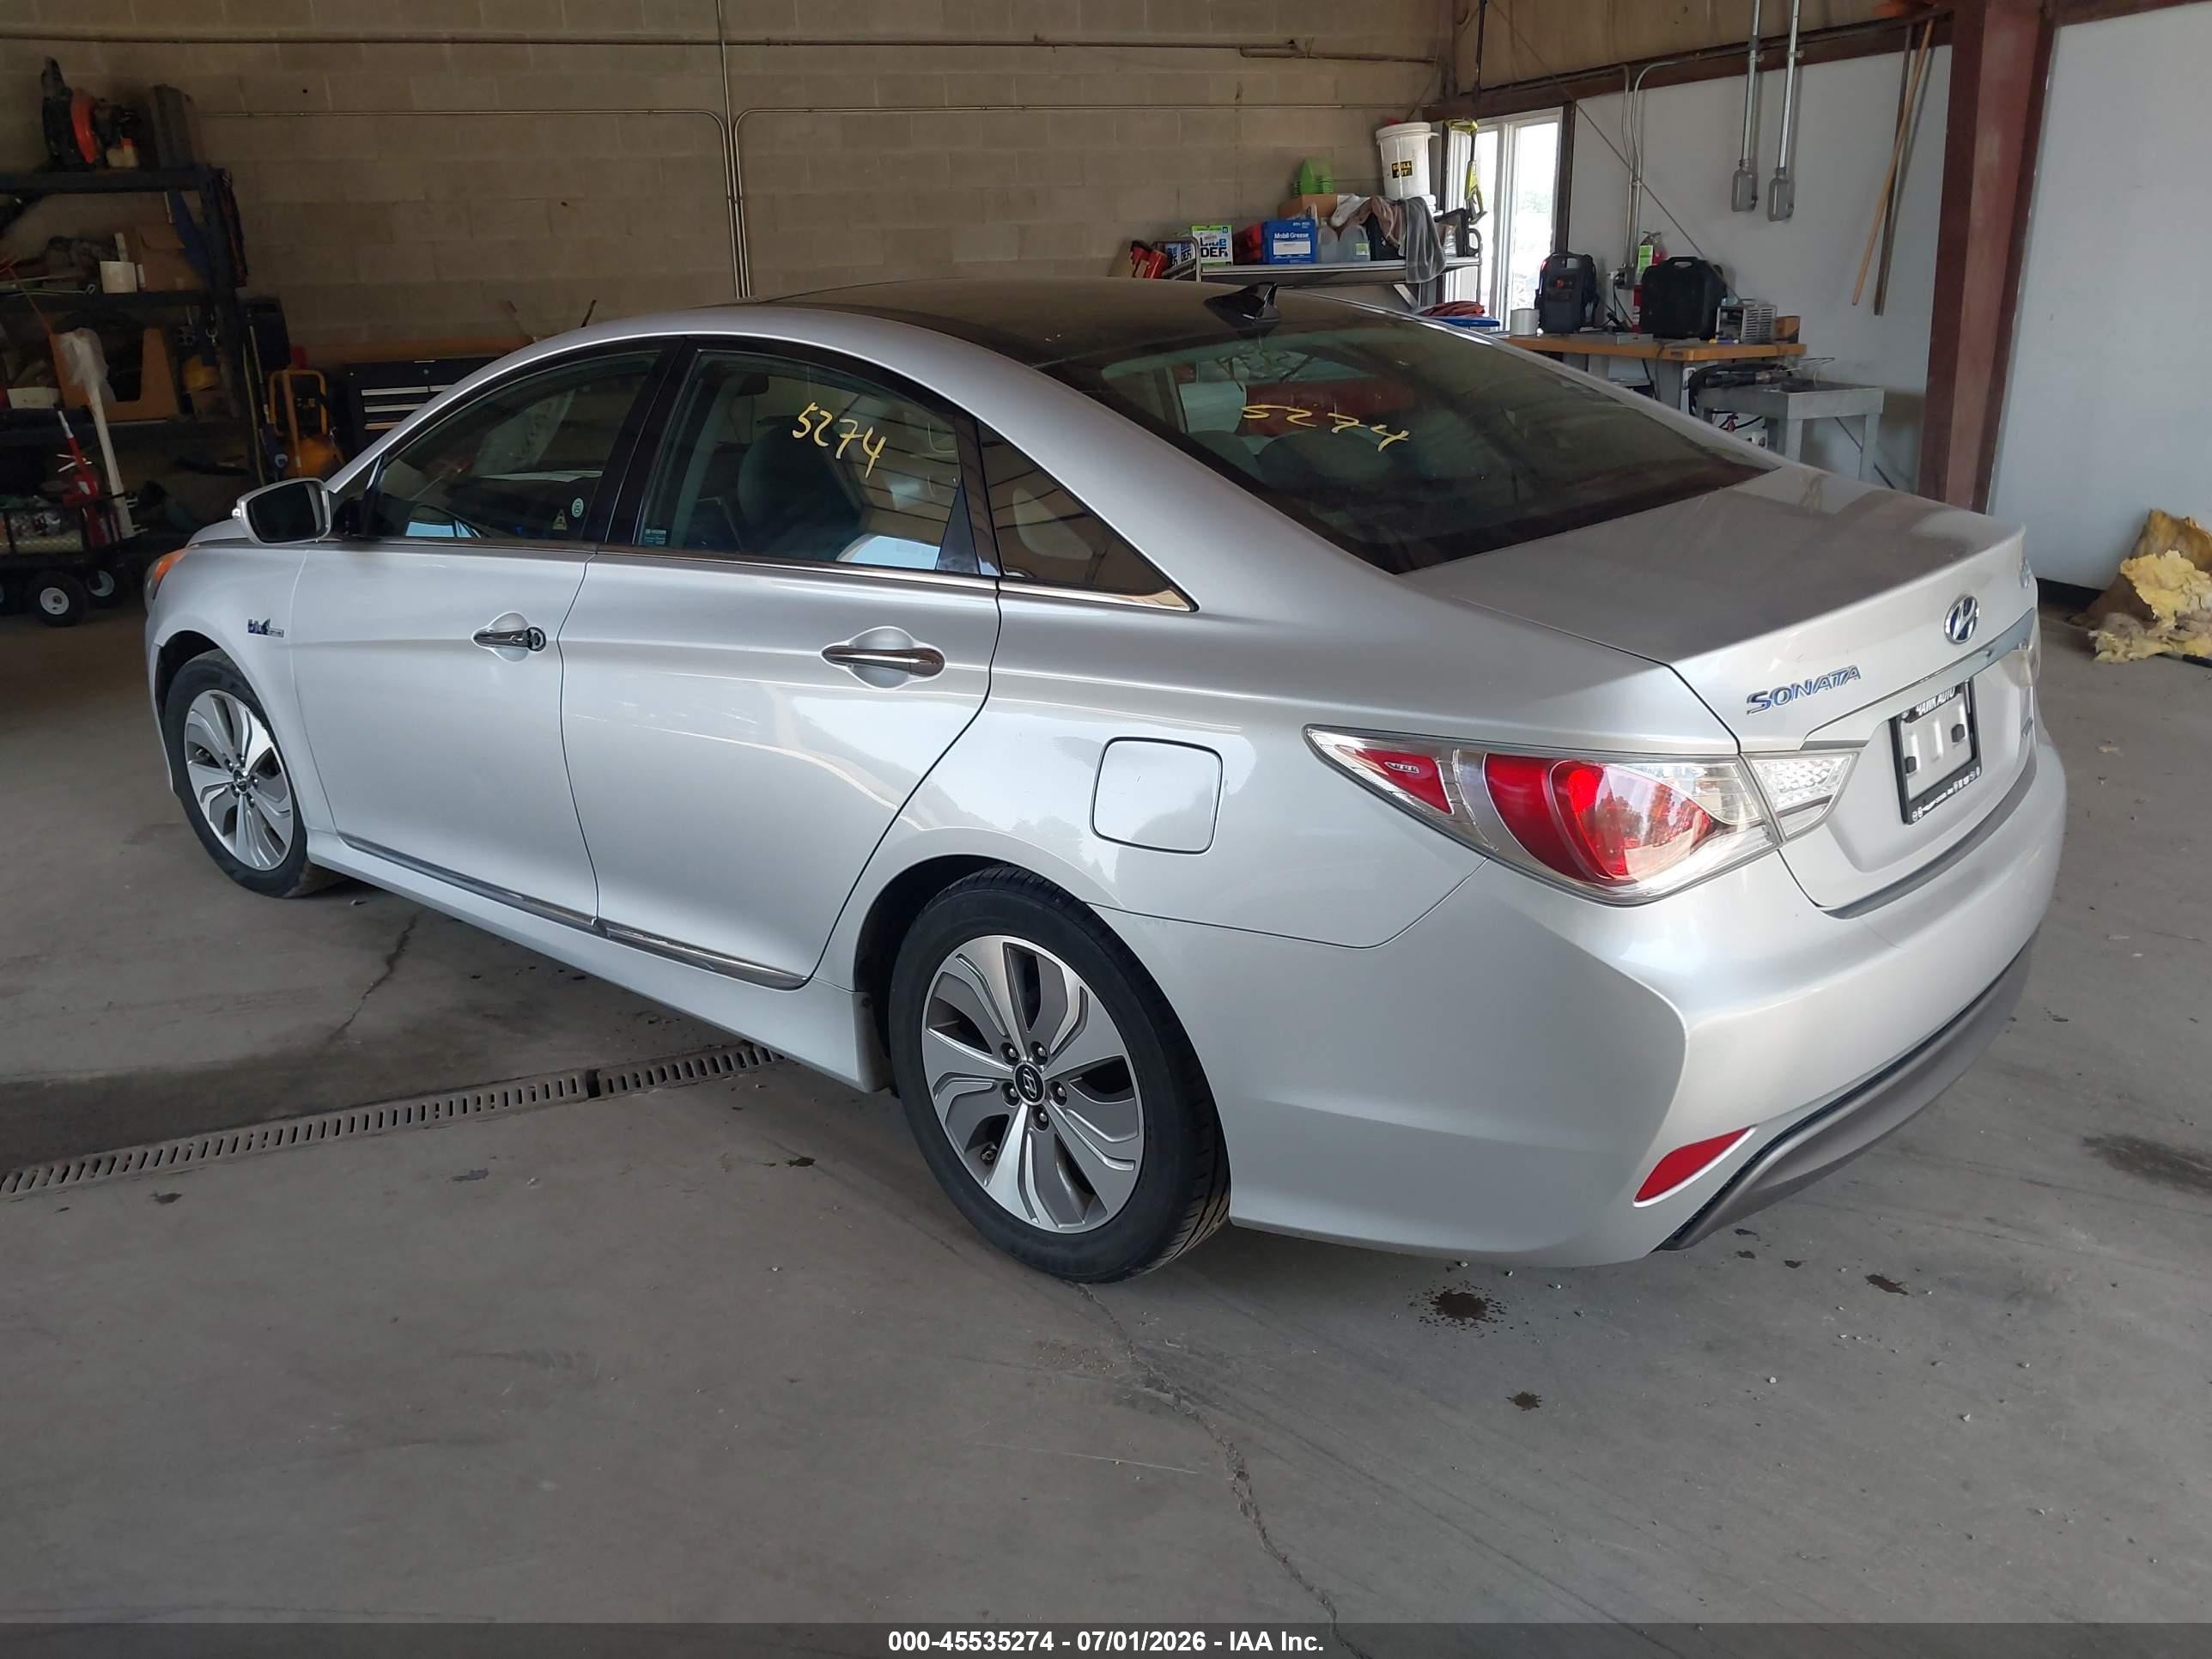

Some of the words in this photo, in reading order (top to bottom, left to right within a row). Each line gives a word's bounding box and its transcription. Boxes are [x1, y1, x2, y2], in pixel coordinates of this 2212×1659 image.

[1200, 246, 1227, 258] DEF
[792, 402, 887, 479] 5274
[1746, 665, 1862, 714] SONATA
